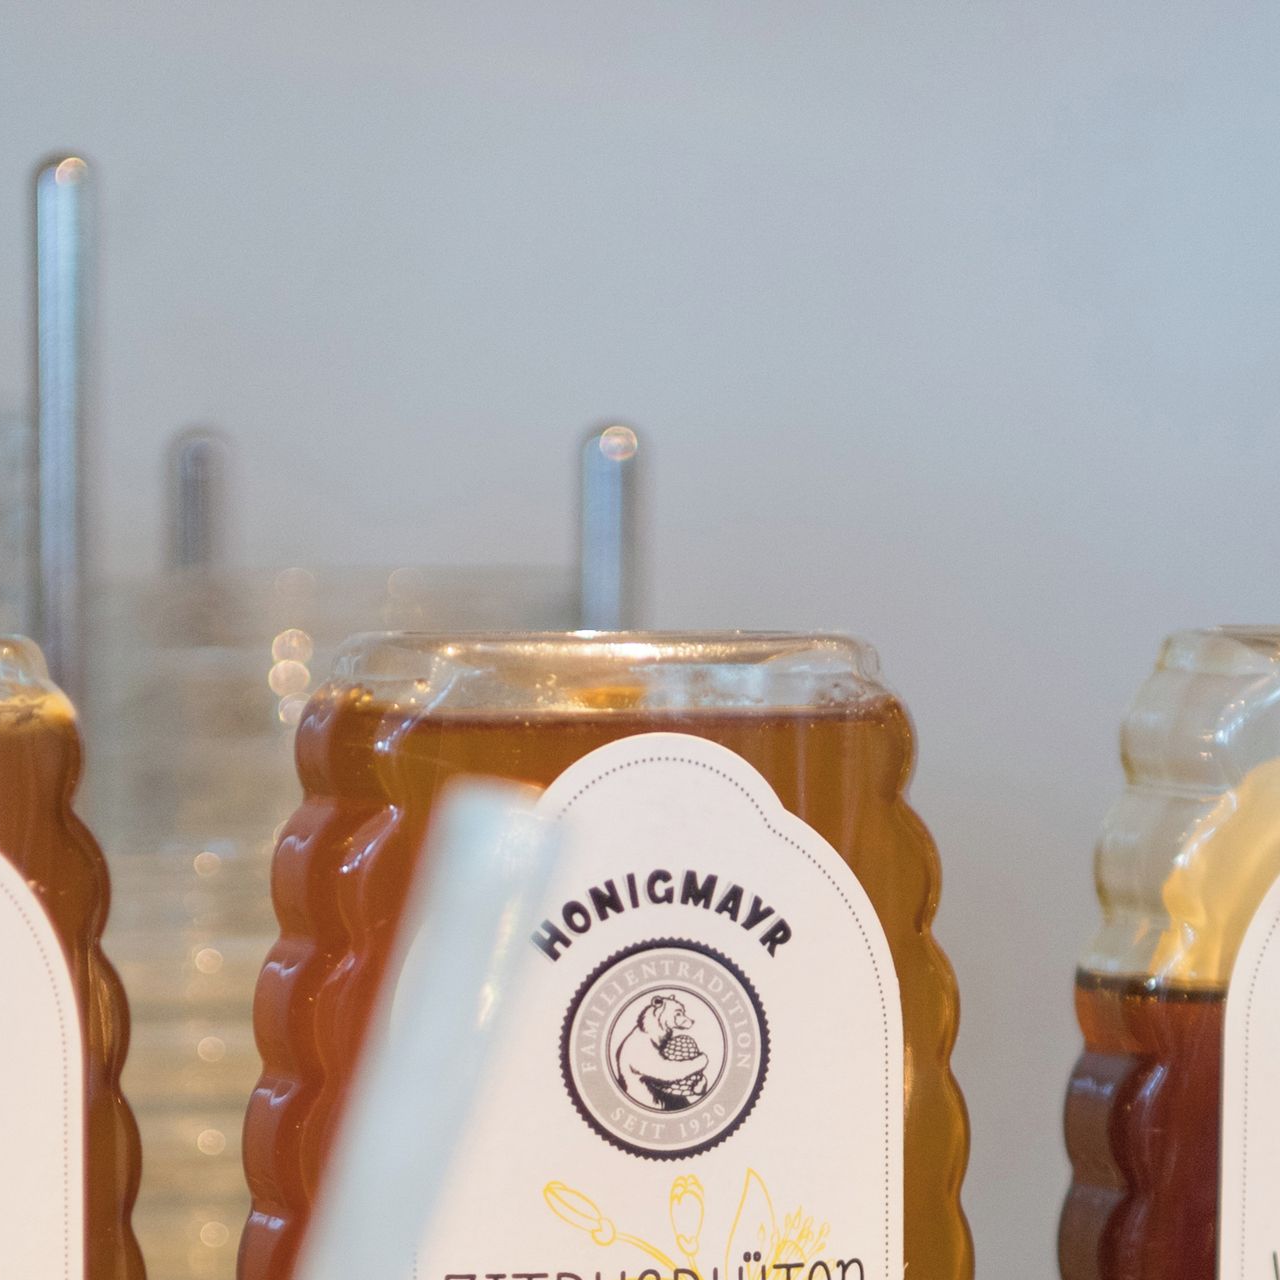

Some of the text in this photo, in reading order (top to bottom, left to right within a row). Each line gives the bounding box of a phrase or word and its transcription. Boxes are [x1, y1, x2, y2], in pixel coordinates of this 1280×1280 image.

[530, 868, 793, 962] HONIGMAYR
[580, 959, 752, 1074] FAMILIENTRADITION
[611, 1103, 726, 1139] SEIT 1920
